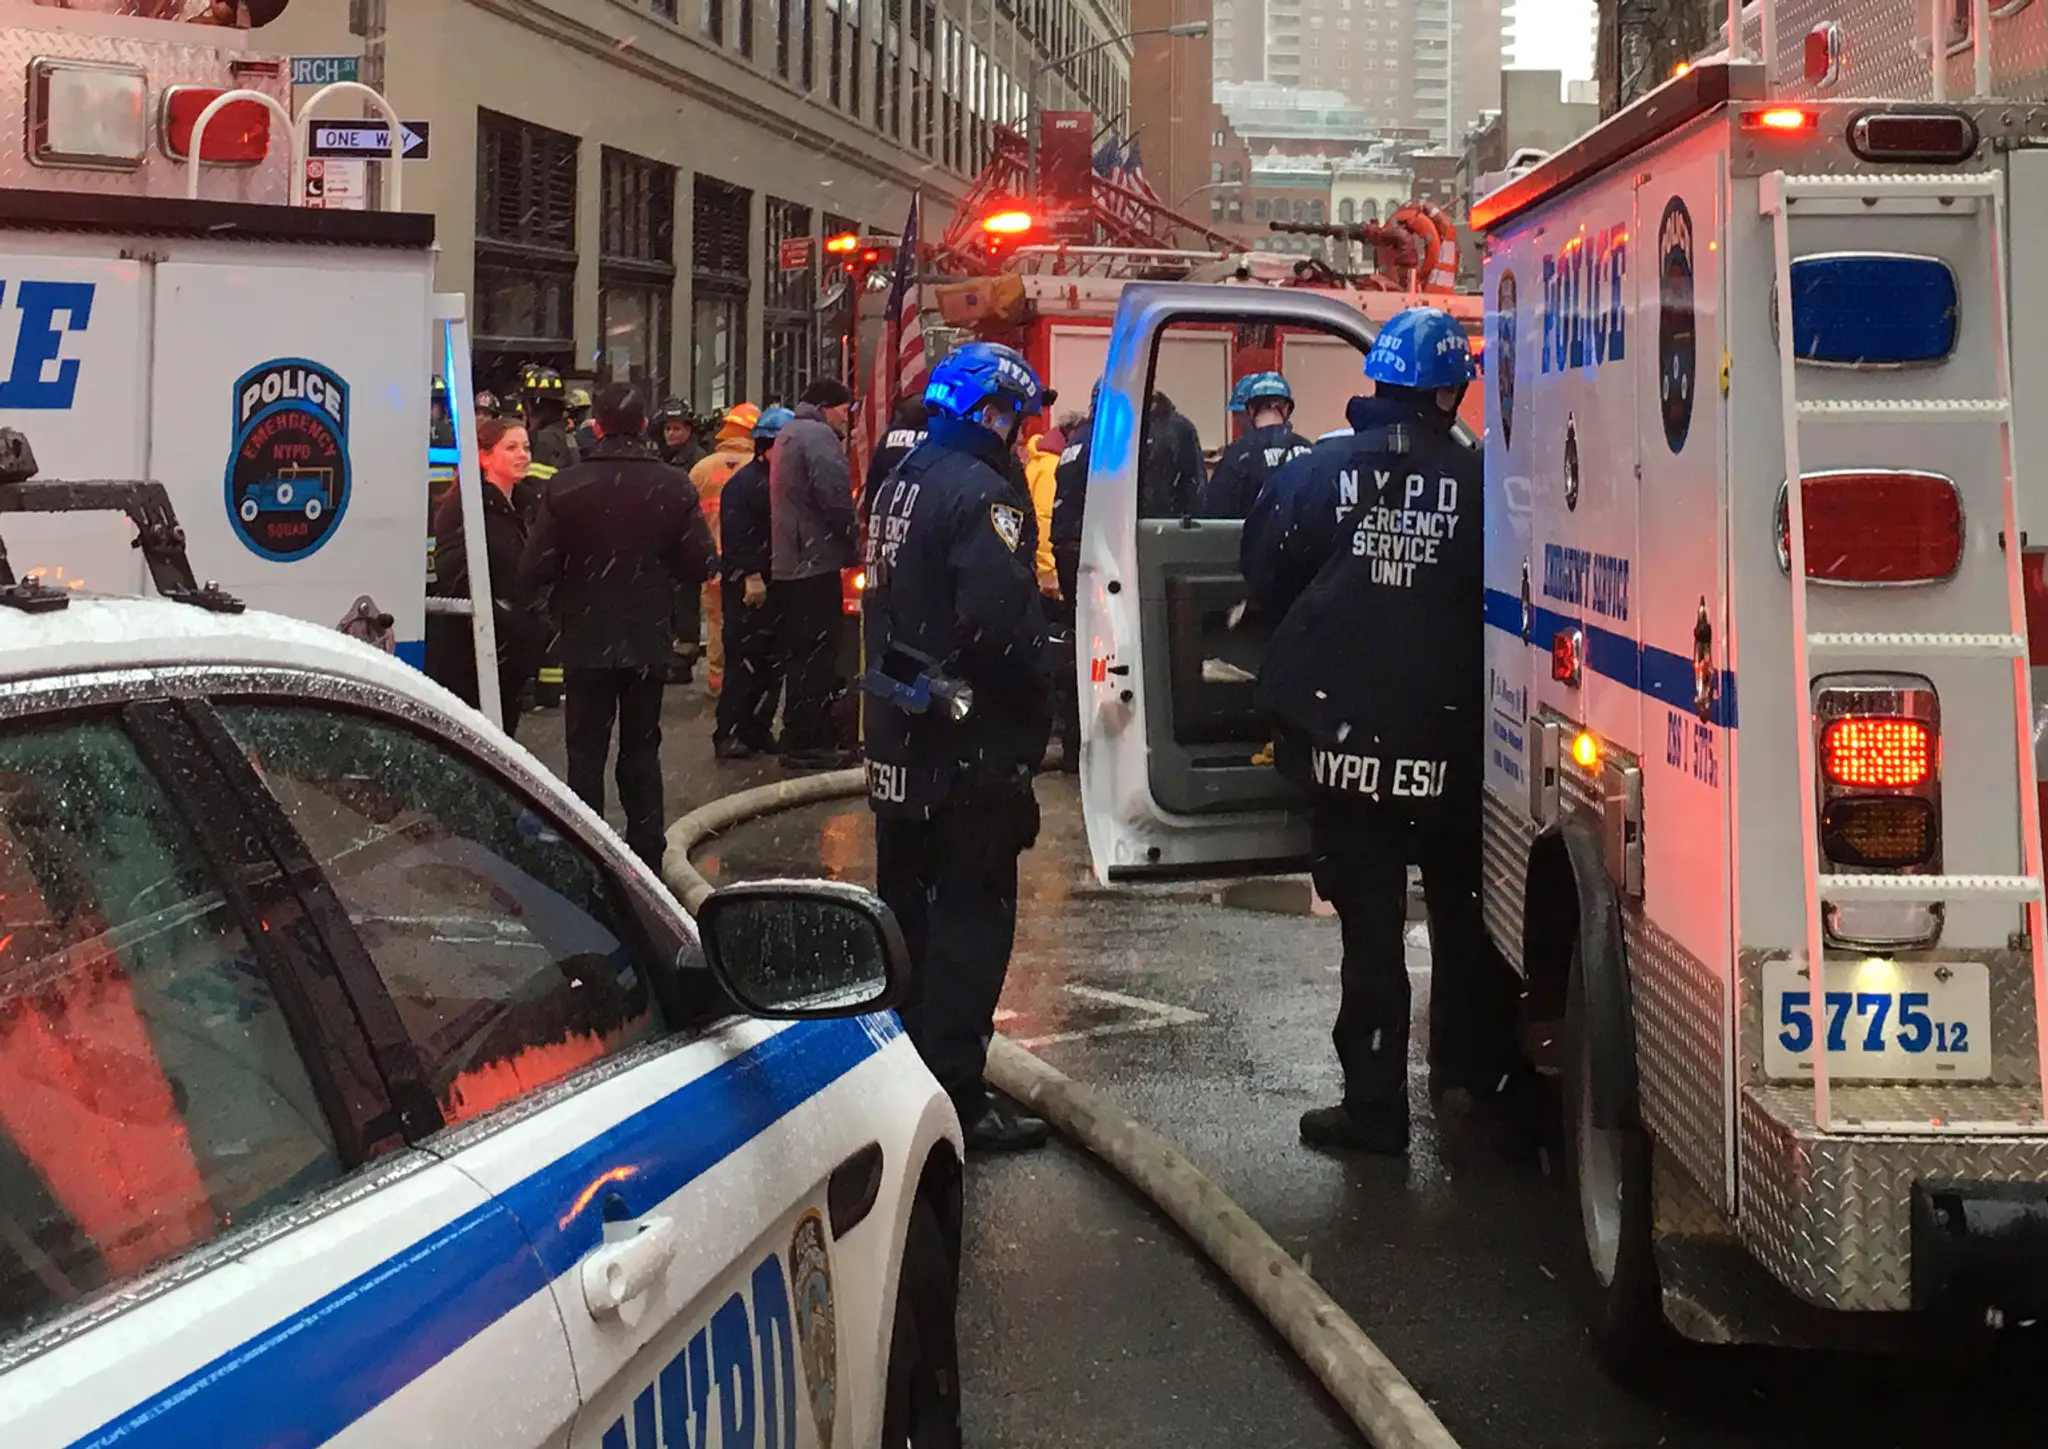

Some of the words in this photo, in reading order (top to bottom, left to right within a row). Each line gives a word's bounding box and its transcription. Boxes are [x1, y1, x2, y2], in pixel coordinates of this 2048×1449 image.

[326, 131, 360, 147] ONE
[376, 132, 411, 147] WY
[1542, 221, 1626, 374] POLICE
[0, 280, 96, 410] E
[1369, 349, 1406, 373] NYPD
[1378, 334, 1402, 350] ESU
[242, 369, 341, 422] POLICE
[998, 357, 1036, 398] NYPD
[243, 411, 337, 460] EMERGENCY
[273, 444, 312, 460] NYPD
[267, 522, 308, 539] SQUAD
[1352, 530, 1440, 564] SERVICE
[1371, 559, 1416, 588] UNIT
[1392, 758, 1447, 798] ESU
[1779, 991, 1933, 1054] 5775
[1935, 1021, 1969, 1053] 12
[602, 1252, 797, 1449] YPD
